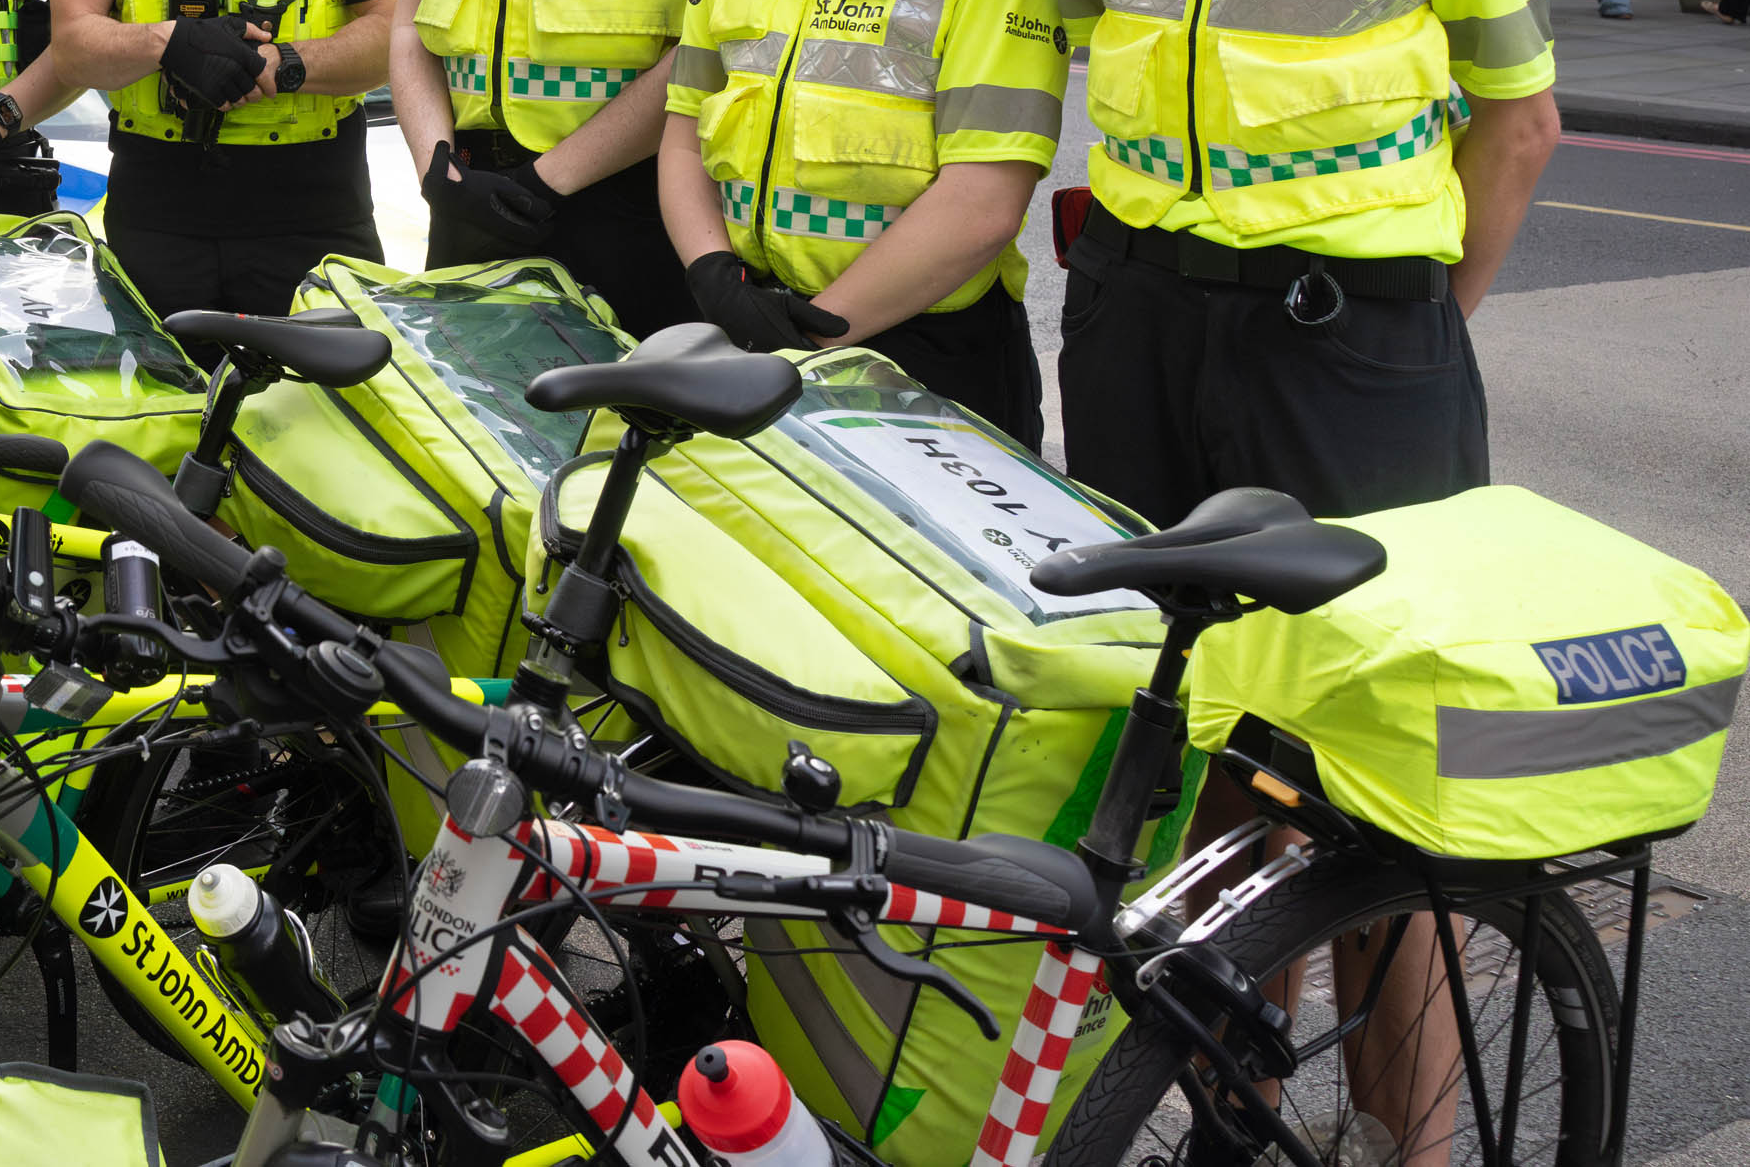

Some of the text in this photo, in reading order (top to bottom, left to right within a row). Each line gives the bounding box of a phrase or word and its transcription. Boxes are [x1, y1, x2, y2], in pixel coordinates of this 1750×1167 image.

[809, 17, 882, 34] Ambulance
[1004, 25, 1050, 44] Ambulance
[1005, 11, 1051, 35] St John
[905, 437, 1029, 517] 103H
[1538, 630, 1682, 698] POLICE
[418, 895, 477, 935] LONDON
[120, 920, 157, 970] St
[146, 951, 208, 1030] John
